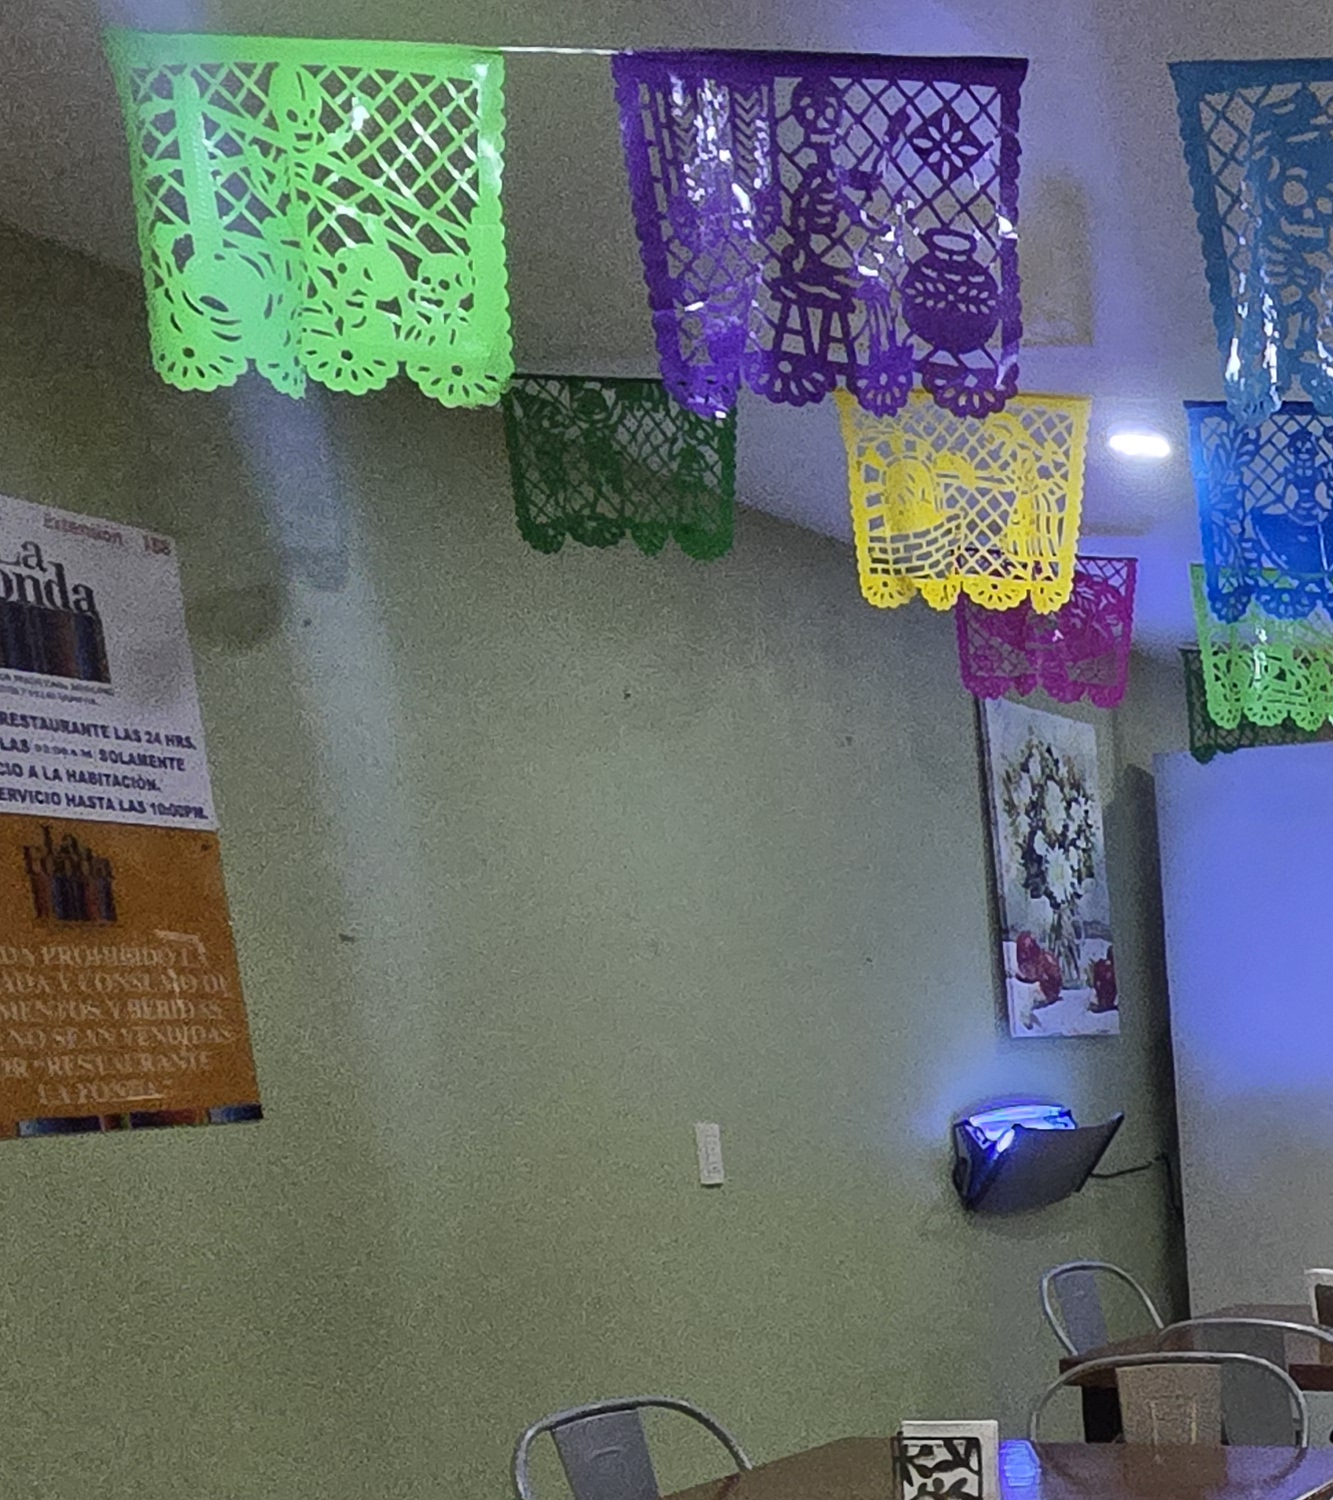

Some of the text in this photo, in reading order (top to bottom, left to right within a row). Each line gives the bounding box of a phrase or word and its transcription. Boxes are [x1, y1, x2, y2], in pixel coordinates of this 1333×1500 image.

[0, 710, 197, 750] RESTAURANTE LAS 24 HRS.
[0, 737, 30, 754] LAS
[98, 748, 186, 772] SOLAMENTE
[28, 765, 39, 779] A
[41, 765, 63, 782] LA
[64, 792, 116, 812] HASTA
[119, 798, 147, 814] LAS
